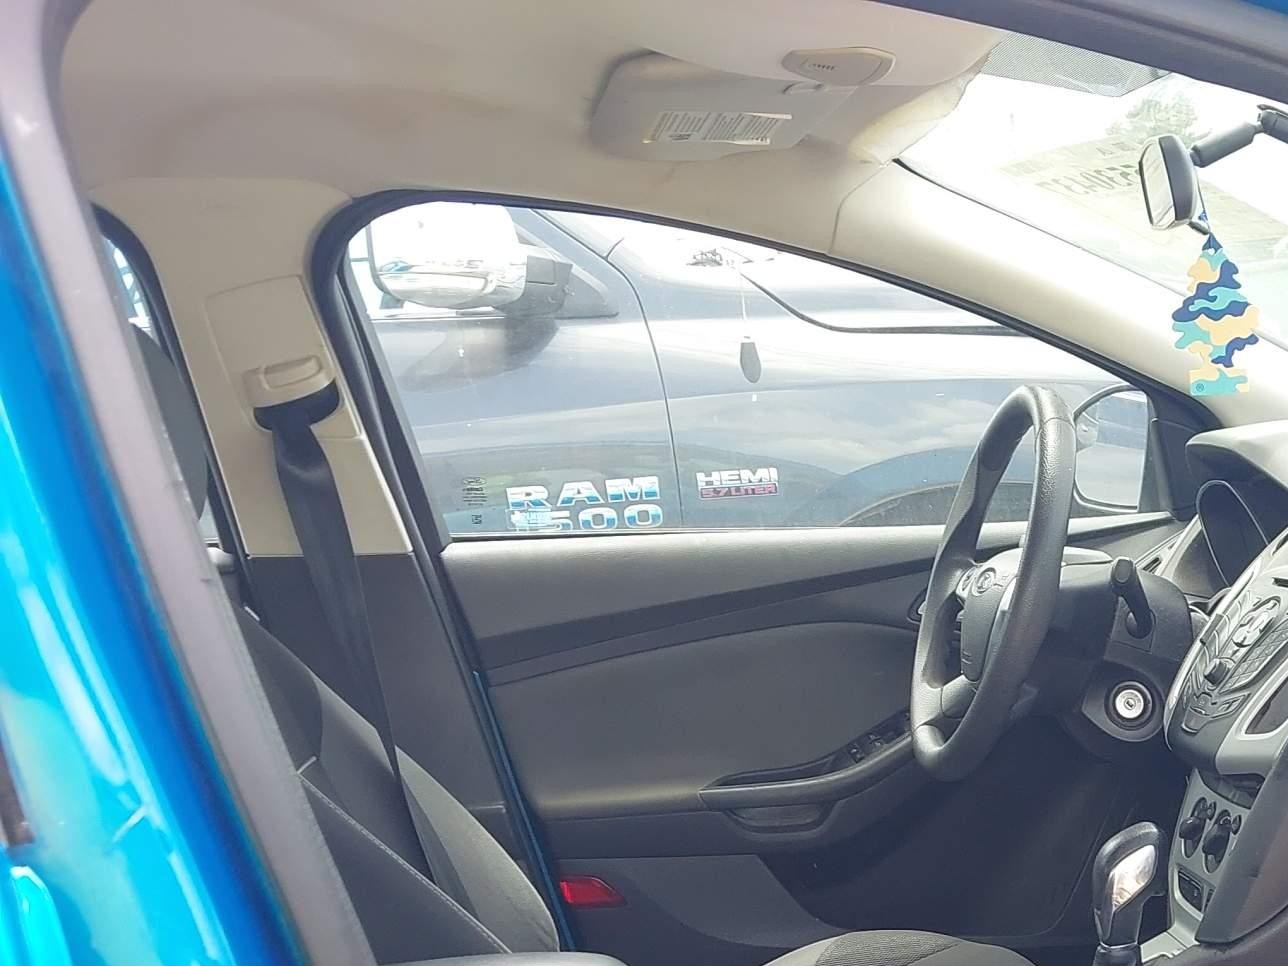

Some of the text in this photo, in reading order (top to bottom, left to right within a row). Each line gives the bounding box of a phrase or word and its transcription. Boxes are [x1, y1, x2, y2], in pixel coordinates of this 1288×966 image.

[696, 467, 779, 488] HEMI
[731, 483, 777, 496] LITER
[505, 475, 661, 510] RAM
[508, 503, 662, 531] 500
